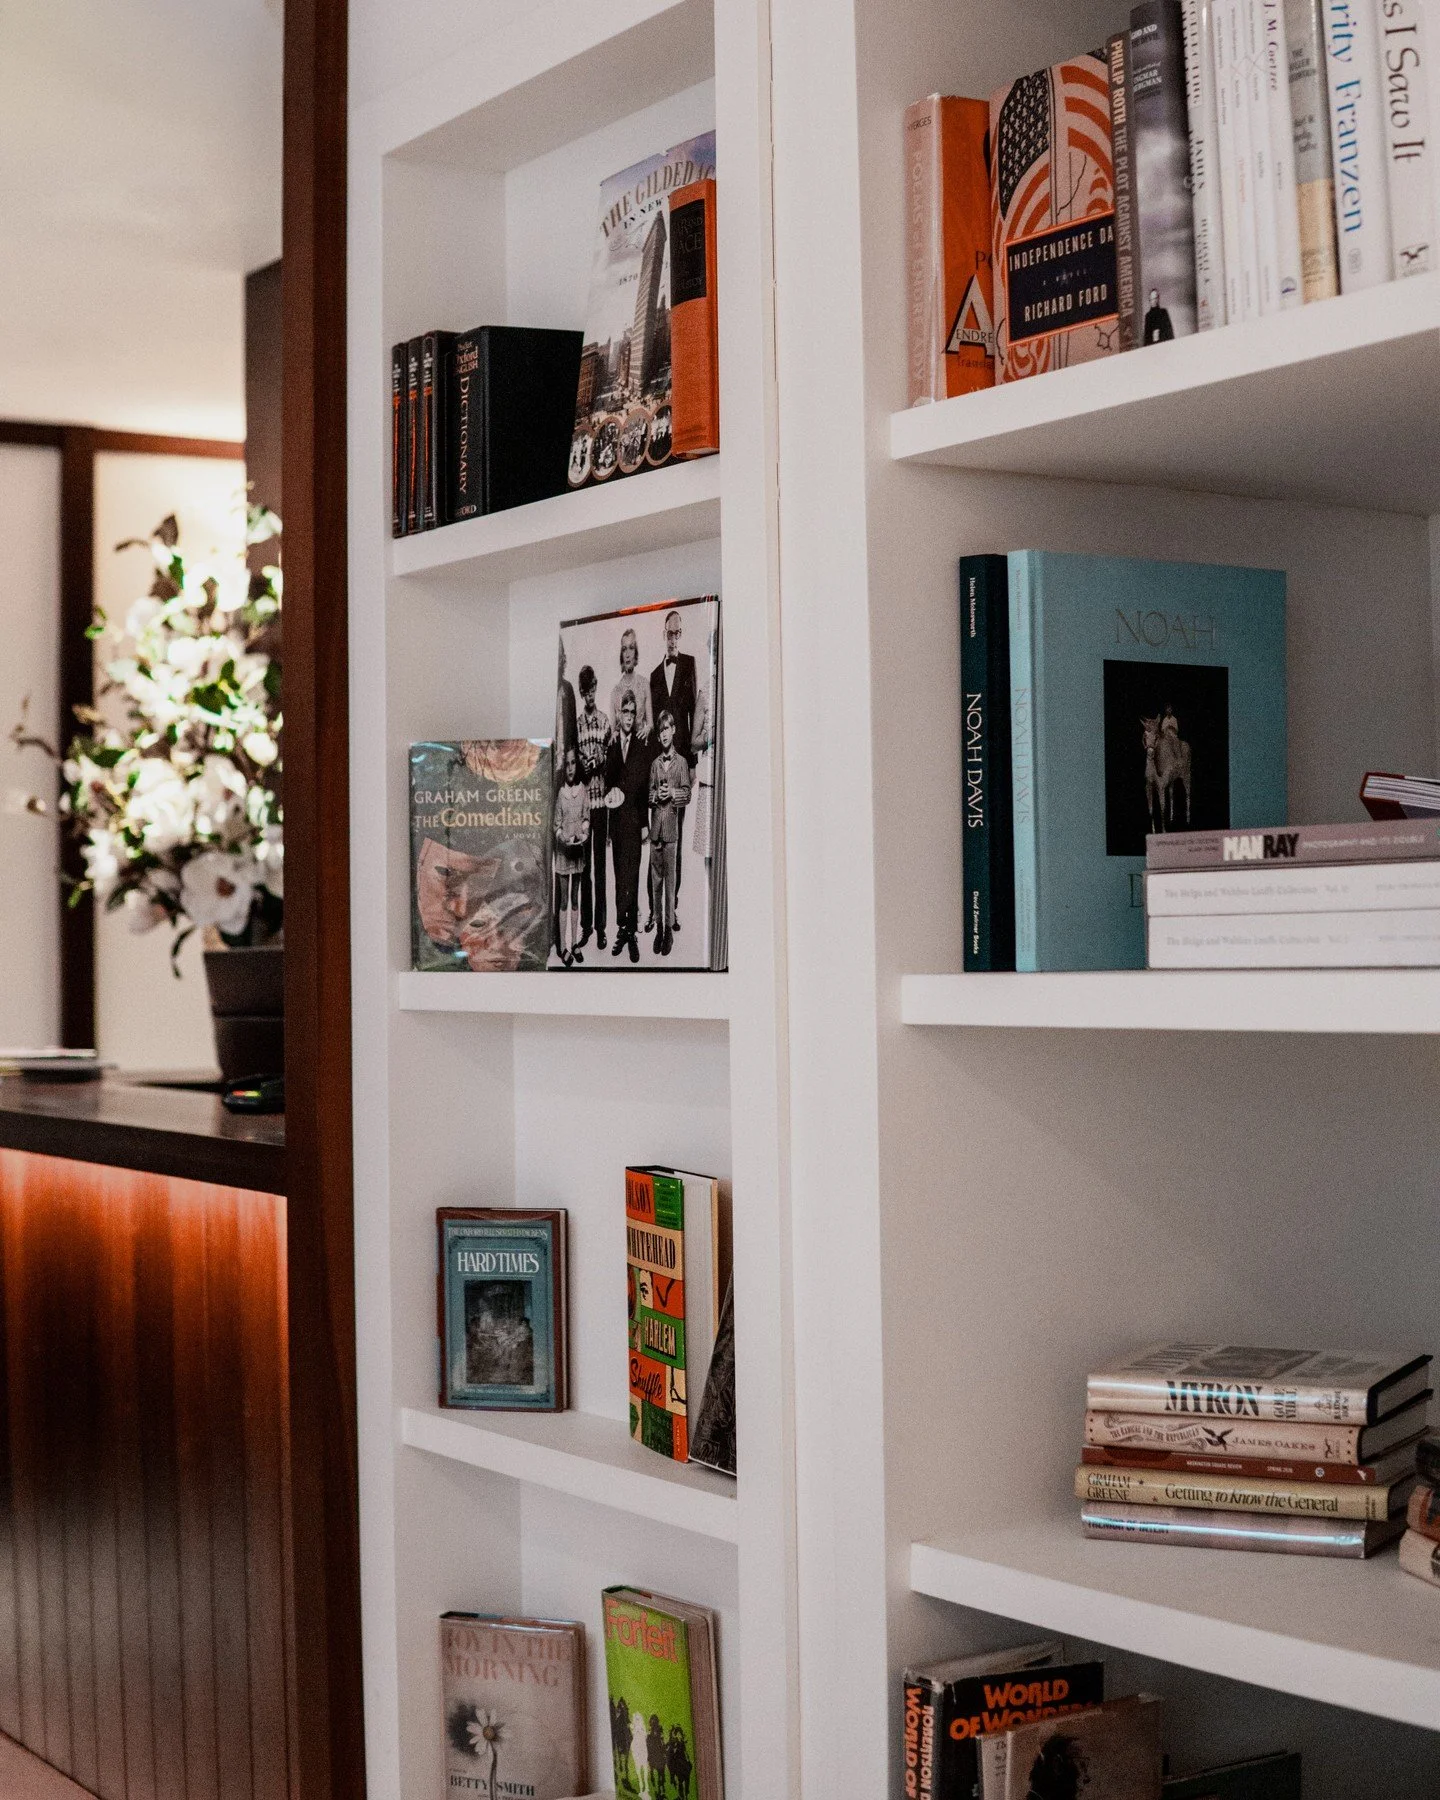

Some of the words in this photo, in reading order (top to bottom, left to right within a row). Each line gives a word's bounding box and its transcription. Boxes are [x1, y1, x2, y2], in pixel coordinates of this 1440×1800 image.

[1385, 24, 1417, 36] I
[1111, 39, 1125, 88] PHILIP
[1112, 88, 1127, 125] ROTH
[1114, 126, 1128, 158] THE
[1336, 79, 1362, 232] Franzen
[1392, 139, 1425, 164] It
[1116, 158, 1131, 191] PLOT
[600, 191, 633, 238] THE
[635, 160, 694, 205] GILDED
[1117, 195, 1132, 251] AGAINST
[1009, 231, 1094, 271] INDEPENDENCE
[1100, 225, 1114, 244] DA
[1024, 294, 1073, 322] RICHARD
[1079, 284, 1107, 307] FORD
[1119, 256, 1135, 318] AMERICA
[956, 328, 994, 341] ENDRE
[460, 376, 470, 494] DICTIONARY
[969, 577, 977, 597] Helen
[969, 598, 978, 638] Molesworth
[1115, 608, 1217, 651] NOAH
[966, 692, 983, 763] NOAH
[414, 790, 479, 804] GRAHAM
[485, 788, 541, 803] GREENE
[967, 769, 984, 829] DAVIS
[414, 815, 440, 829] THE
[440, 807, 541, 828] Comedians
[1263, 832, 1300, 859] RAY
[457, 1252, 496, 1273] HARD
[495, 1252, 540, 1274] TIMES
[644, 1316, 676, 1358] HARLEM
[630, 1358, 663, 1402] Shuffle
[1164, 1380, 1263, 1416] MYRON
[1110, 1430, 1121, 1439] THE
[1232, 1437, 1272, 1447] JAMES
[1274, 1440, 1316, 1450] OAKES
[1087, 1472, 1131, 1489] GRAHAM
[1087, 1487, 1131, 1500] GREENE
[1165, 1483, 1213, 1503] Getting
[1215, 1491, 1228, 1503] to
[1265, 1492, 1288, 1508] the
[1288, 1493, 1339, 1512] General
[603, 1598, 679, 1664] Forfeit
[446, 1654, 559, 1687] MORNING
[983, 1678, 1070, 1709] WORLD
[905, 1687, 922, 1768] WORLD
[949, 1716, 981, 1741] OF
[981, 1702, 1093, 1733] WOND
[921, 1705, 935, 1790] ROBERTSON
[450, 1776, 488, 1794] BETTY
[495, 1782, 535, 1797] SMITH
[905, 1769, 917, 1799] OF
